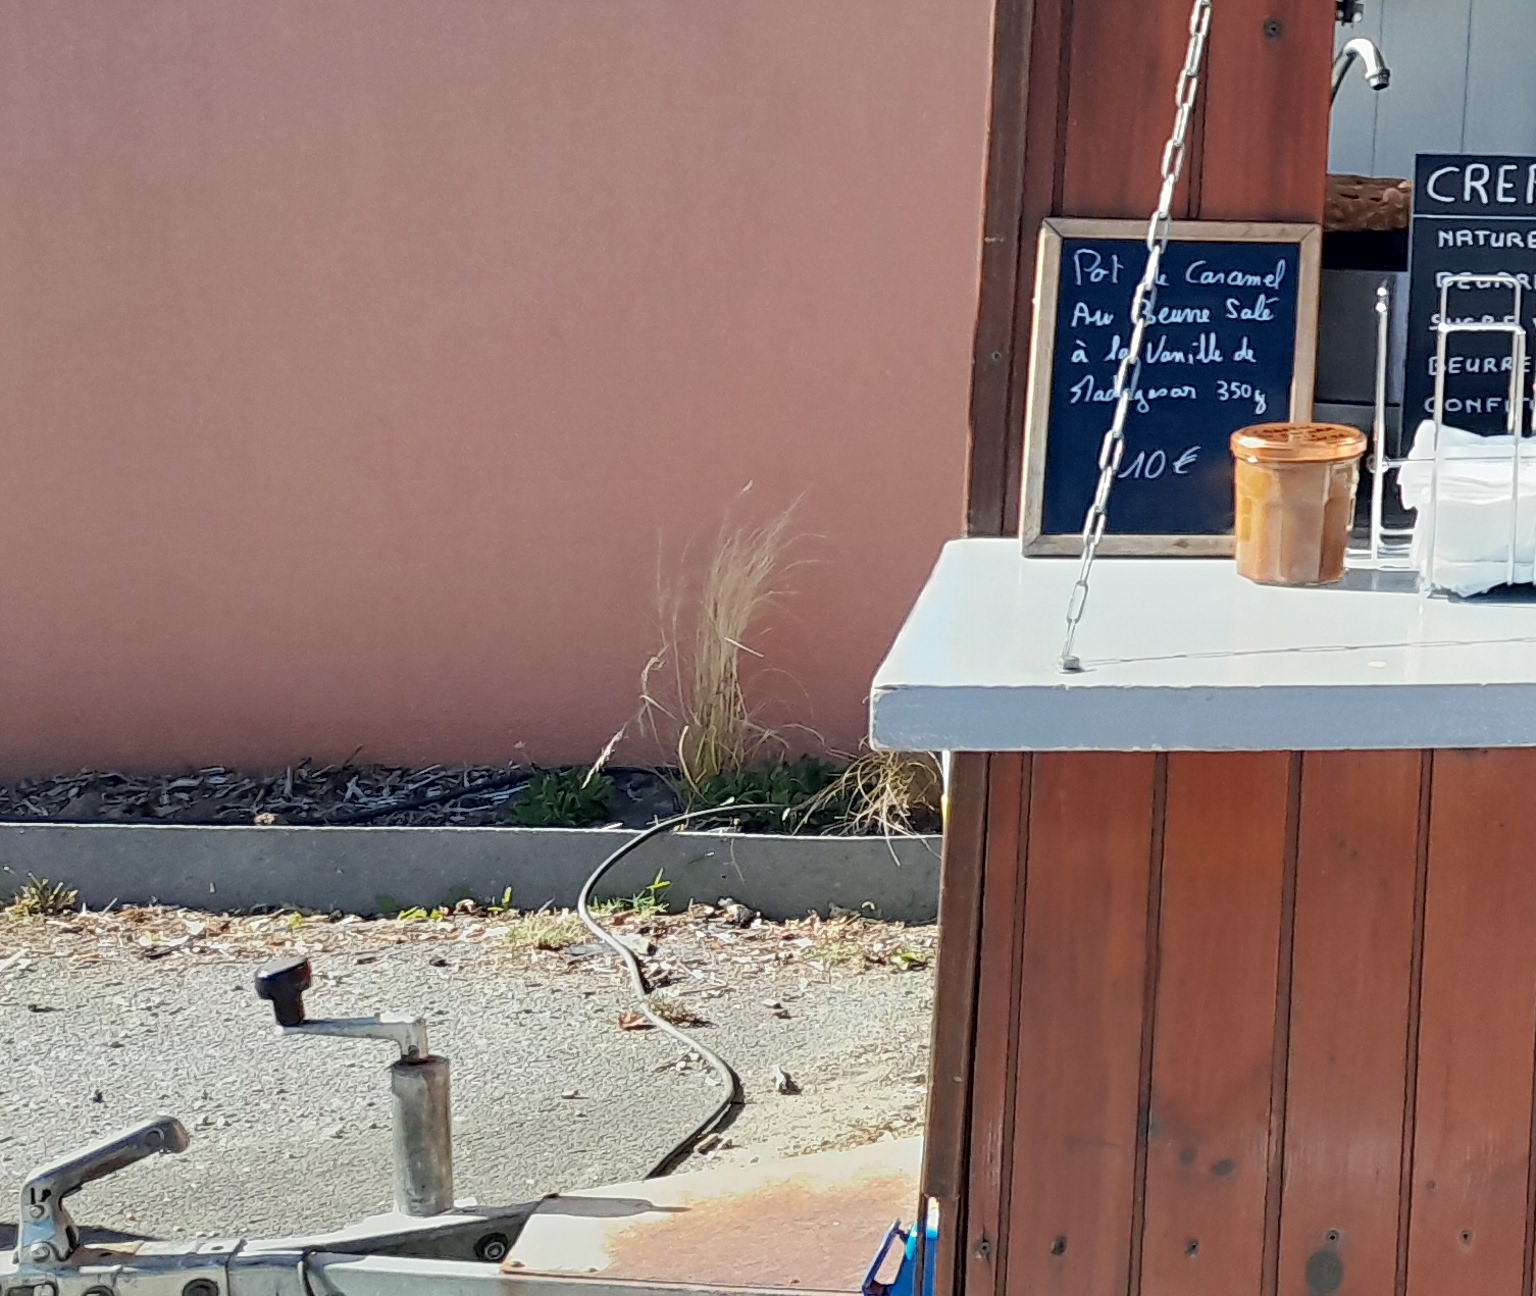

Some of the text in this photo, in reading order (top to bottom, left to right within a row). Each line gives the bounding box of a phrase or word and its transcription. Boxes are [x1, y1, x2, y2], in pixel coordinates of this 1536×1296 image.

[1074, 249, 1124, 285] Pot
[1185, 259, 1287, 291] Caramel
[1070, 302, 1115, 328] Au
[1226, 292, 1280, 322] Salé
[1071, 340, 1090, 364] à
[1146, 331, 1224, 365] Vanille
[1233, 336, 1257, 364] de
[1117, 446, 1201, 479] 10 €
